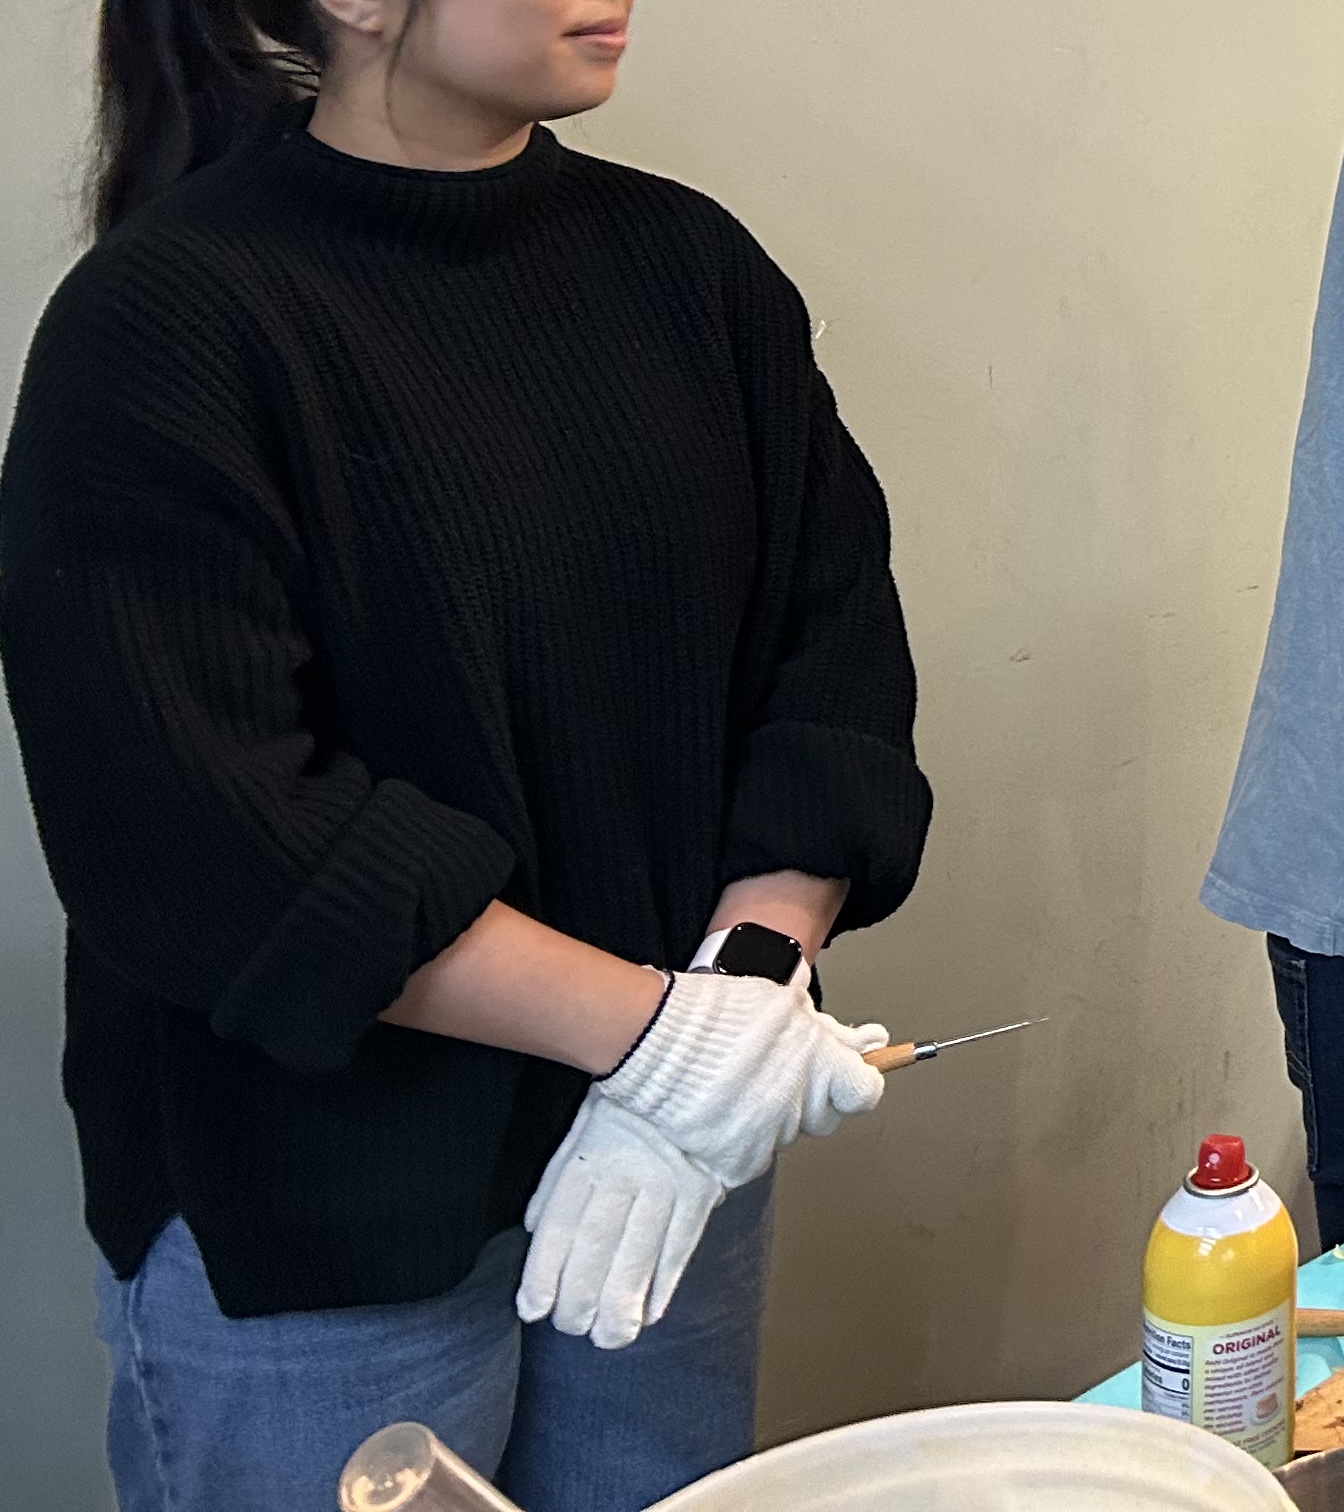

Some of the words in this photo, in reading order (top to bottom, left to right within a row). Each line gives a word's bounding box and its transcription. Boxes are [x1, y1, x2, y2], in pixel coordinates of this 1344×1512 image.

[1166, 1335, 1192, 1351] Facts
[1212, 1325, 1282, 1356] ORIGINAL
[1181, 1378, 1190, 1391] 0
